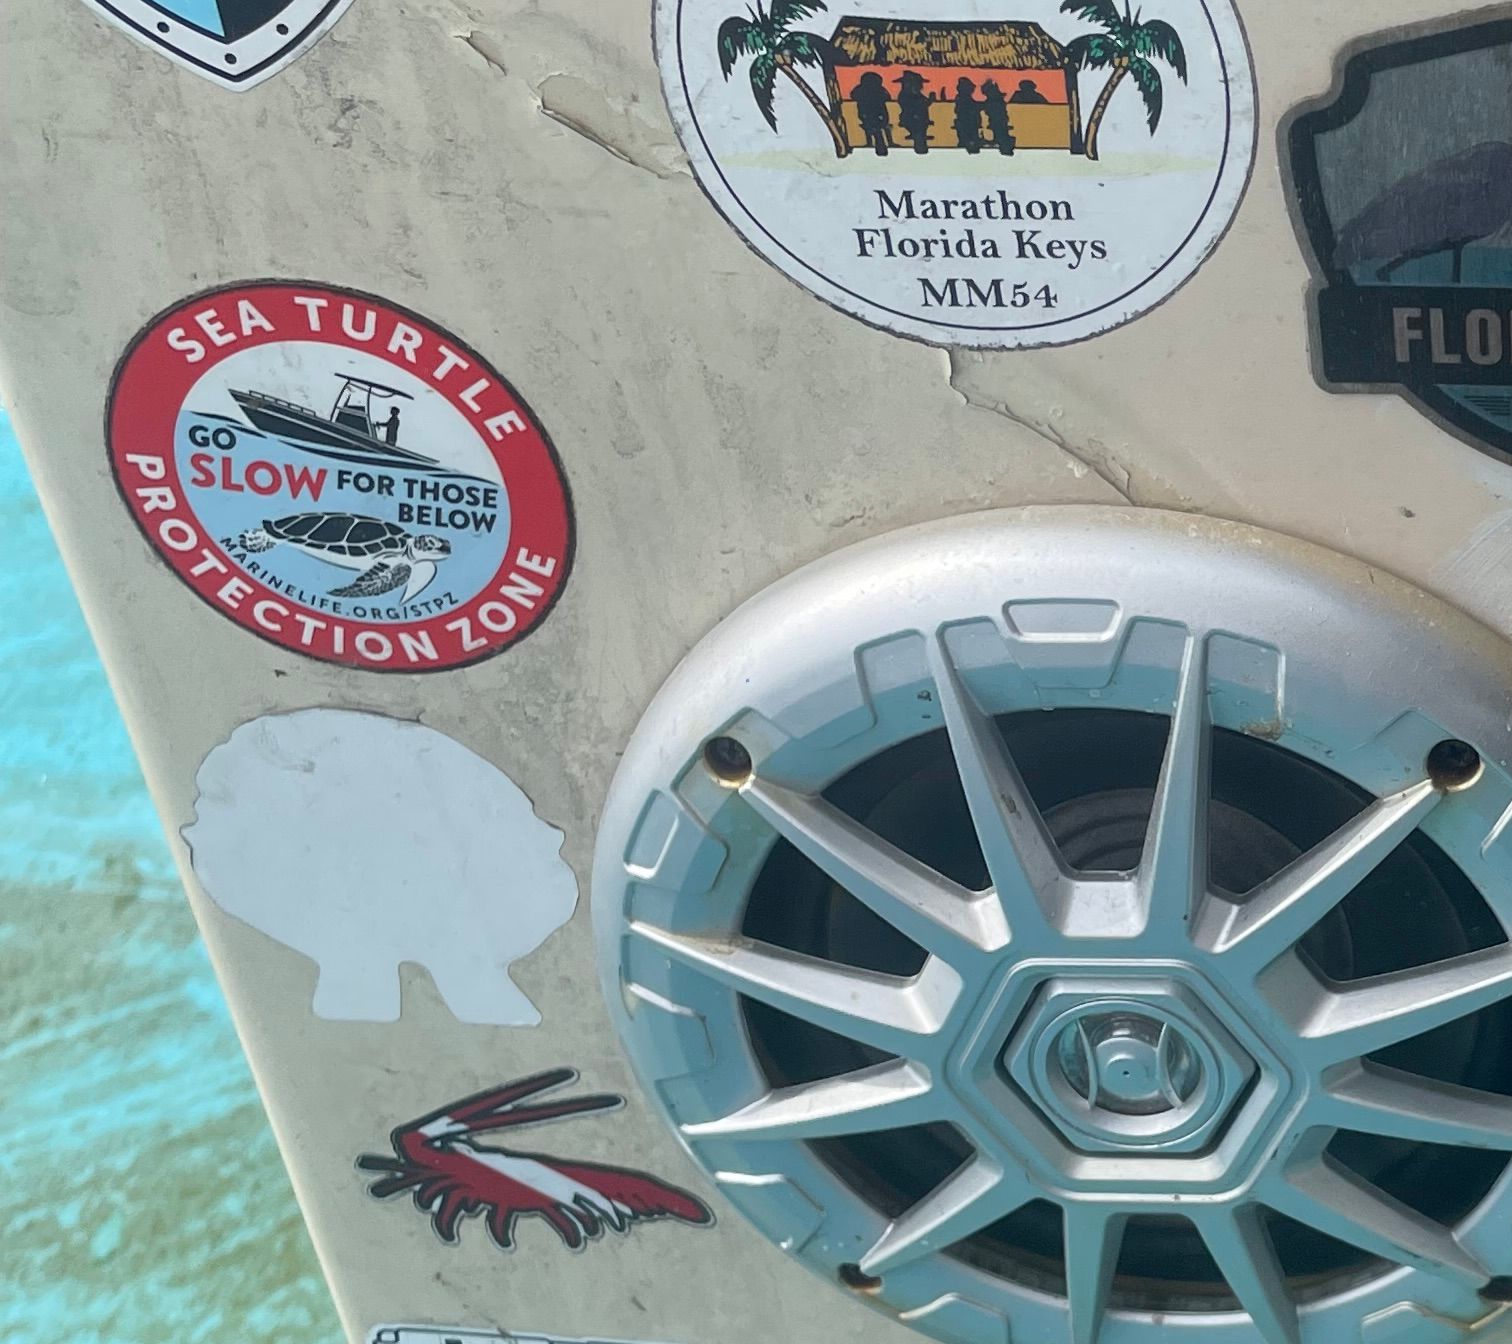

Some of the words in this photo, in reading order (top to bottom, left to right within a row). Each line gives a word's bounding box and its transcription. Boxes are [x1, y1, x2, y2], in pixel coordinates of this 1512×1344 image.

[873, 189, 1073, 221] Marathon
[856, 227, 999, 260] Florida
[1014, 229, 1107, 269] Keys
[920, 277, 1058, 309] MM54
[167, 299, 273, 364] SEA
[294, 296, 527, 441] TURTLE
[188, 424, 236, 450] GO
[190, 454, 327, 502] SLOW
[337, 470, 394, 496] FOR
[403, 479, 498, 508] THOSE
[399, 504, 496, 533] BELOW
[126, 453, 438, 662] PROTECTION
[447, 546, 556, 651] ZONE
[219, 536, 459, 621] MARINELIFE.ORG/STPZ
